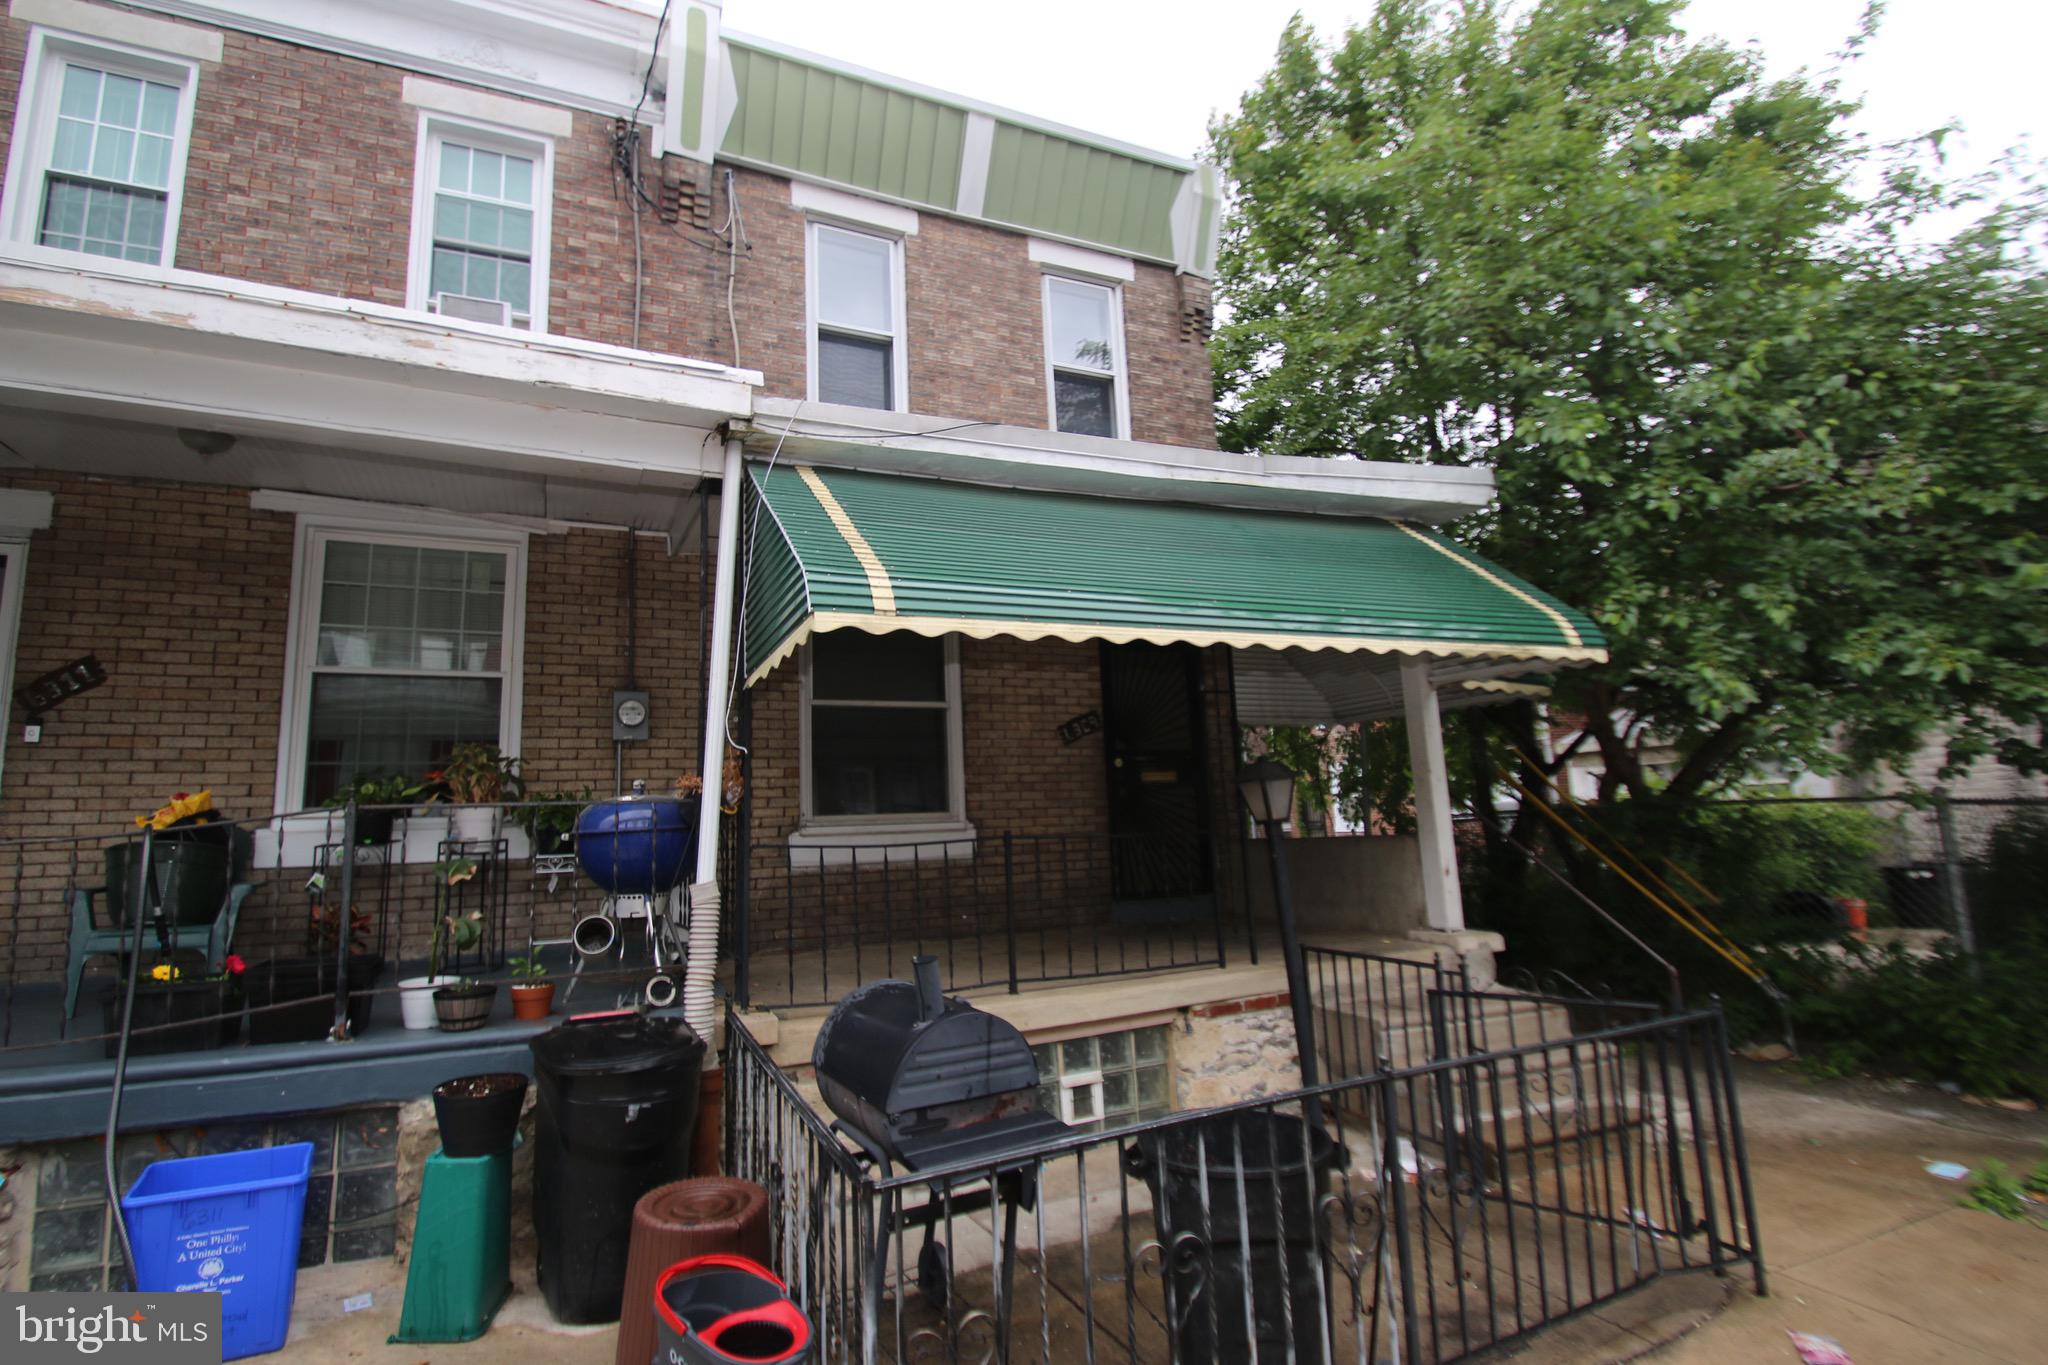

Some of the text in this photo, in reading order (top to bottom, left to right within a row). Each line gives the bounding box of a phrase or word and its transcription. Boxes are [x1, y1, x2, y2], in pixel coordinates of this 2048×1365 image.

[186, 1239, 208, 1250] One
[177, 1252, 187, 1263] A
[189, 1246, 222, 1261] United
